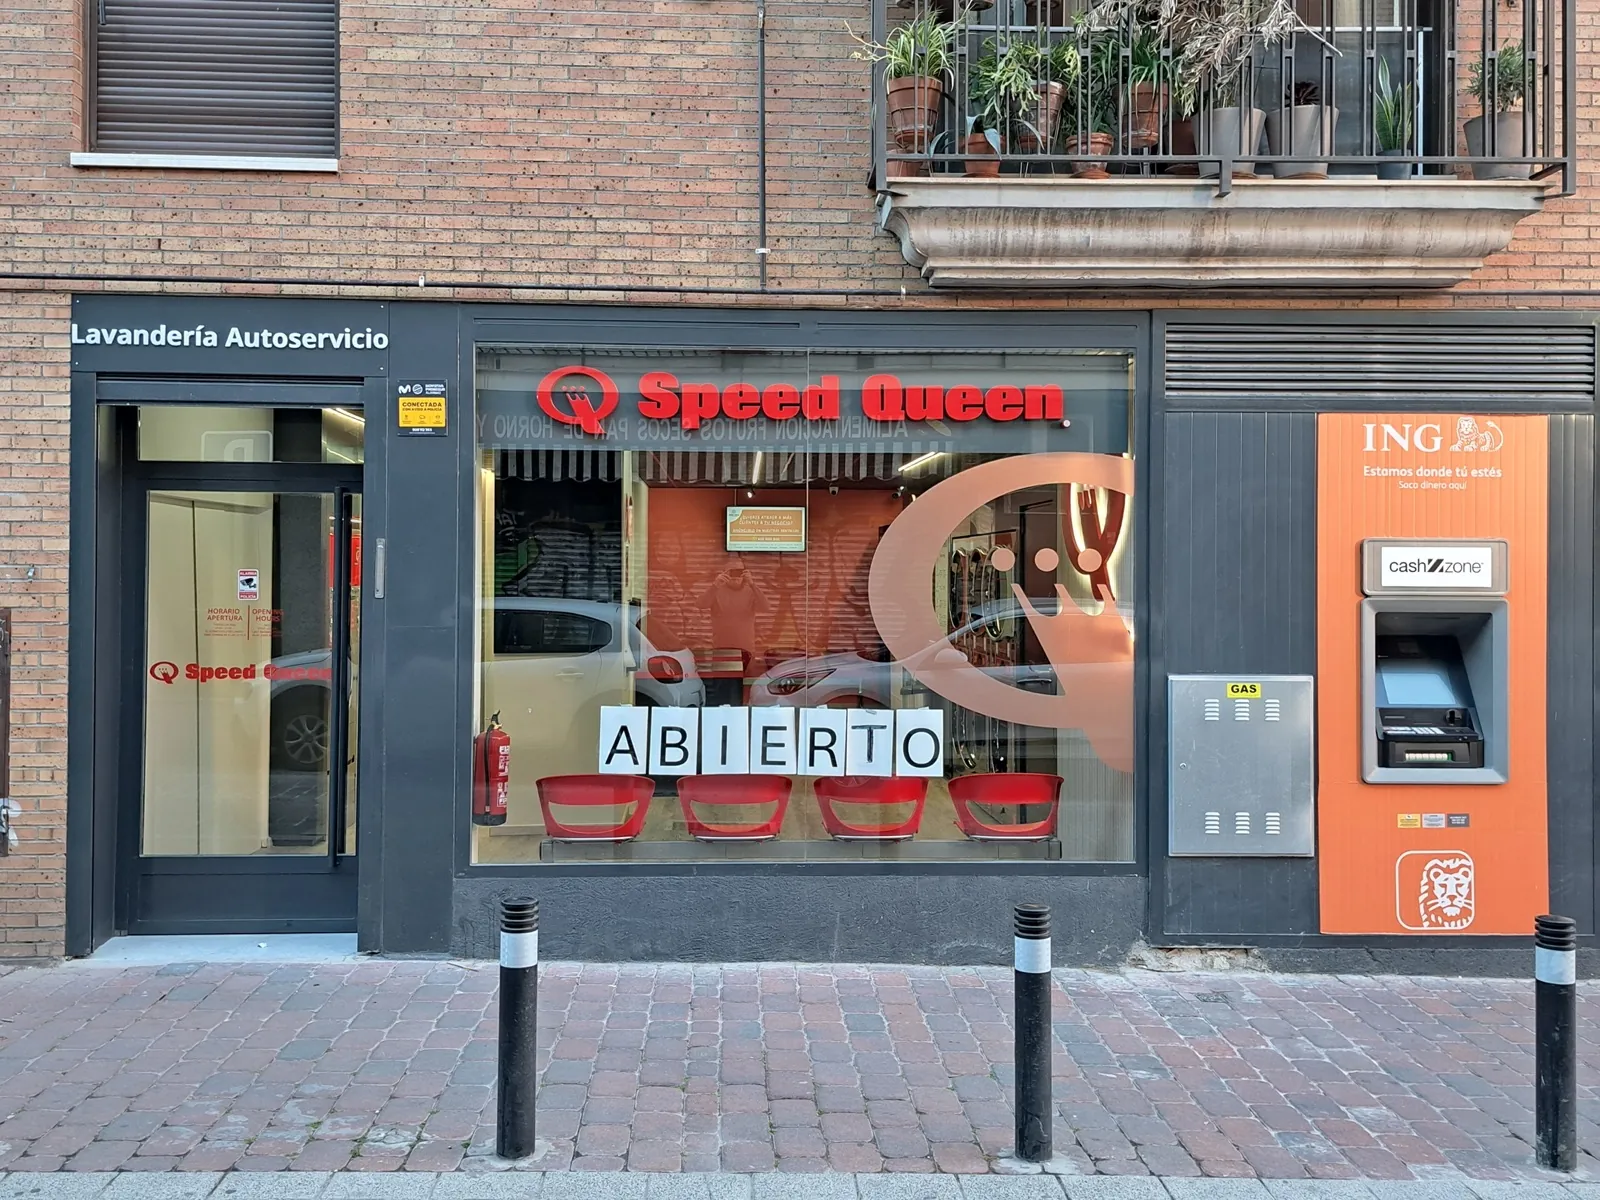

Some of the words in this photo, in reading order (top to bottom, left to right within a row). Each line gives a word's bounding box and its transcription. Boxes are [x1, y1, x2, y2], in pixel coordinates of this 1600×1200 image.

[71, 323, 218, 347] Lavandería
[224, 327, 389, 349] Autoservicio
[638, 371, 840, 430] Speed
[862, 373, 1064, 422] Queen
[1362, 423, 1443, 453] ING
[1363, 465, 1413, 477] Estamos
[1416, 465, 1452, 477] donde
[1455, 466, 1467, 478] tú
[1471, 466, 1502, 478] estés
[1420, 481, 1447, 489] dinero
[185, 663, 256, 683] Speed
[1231, 684, 1257, 694] GAS
[605, 725, 940, 769] ABIERTO
